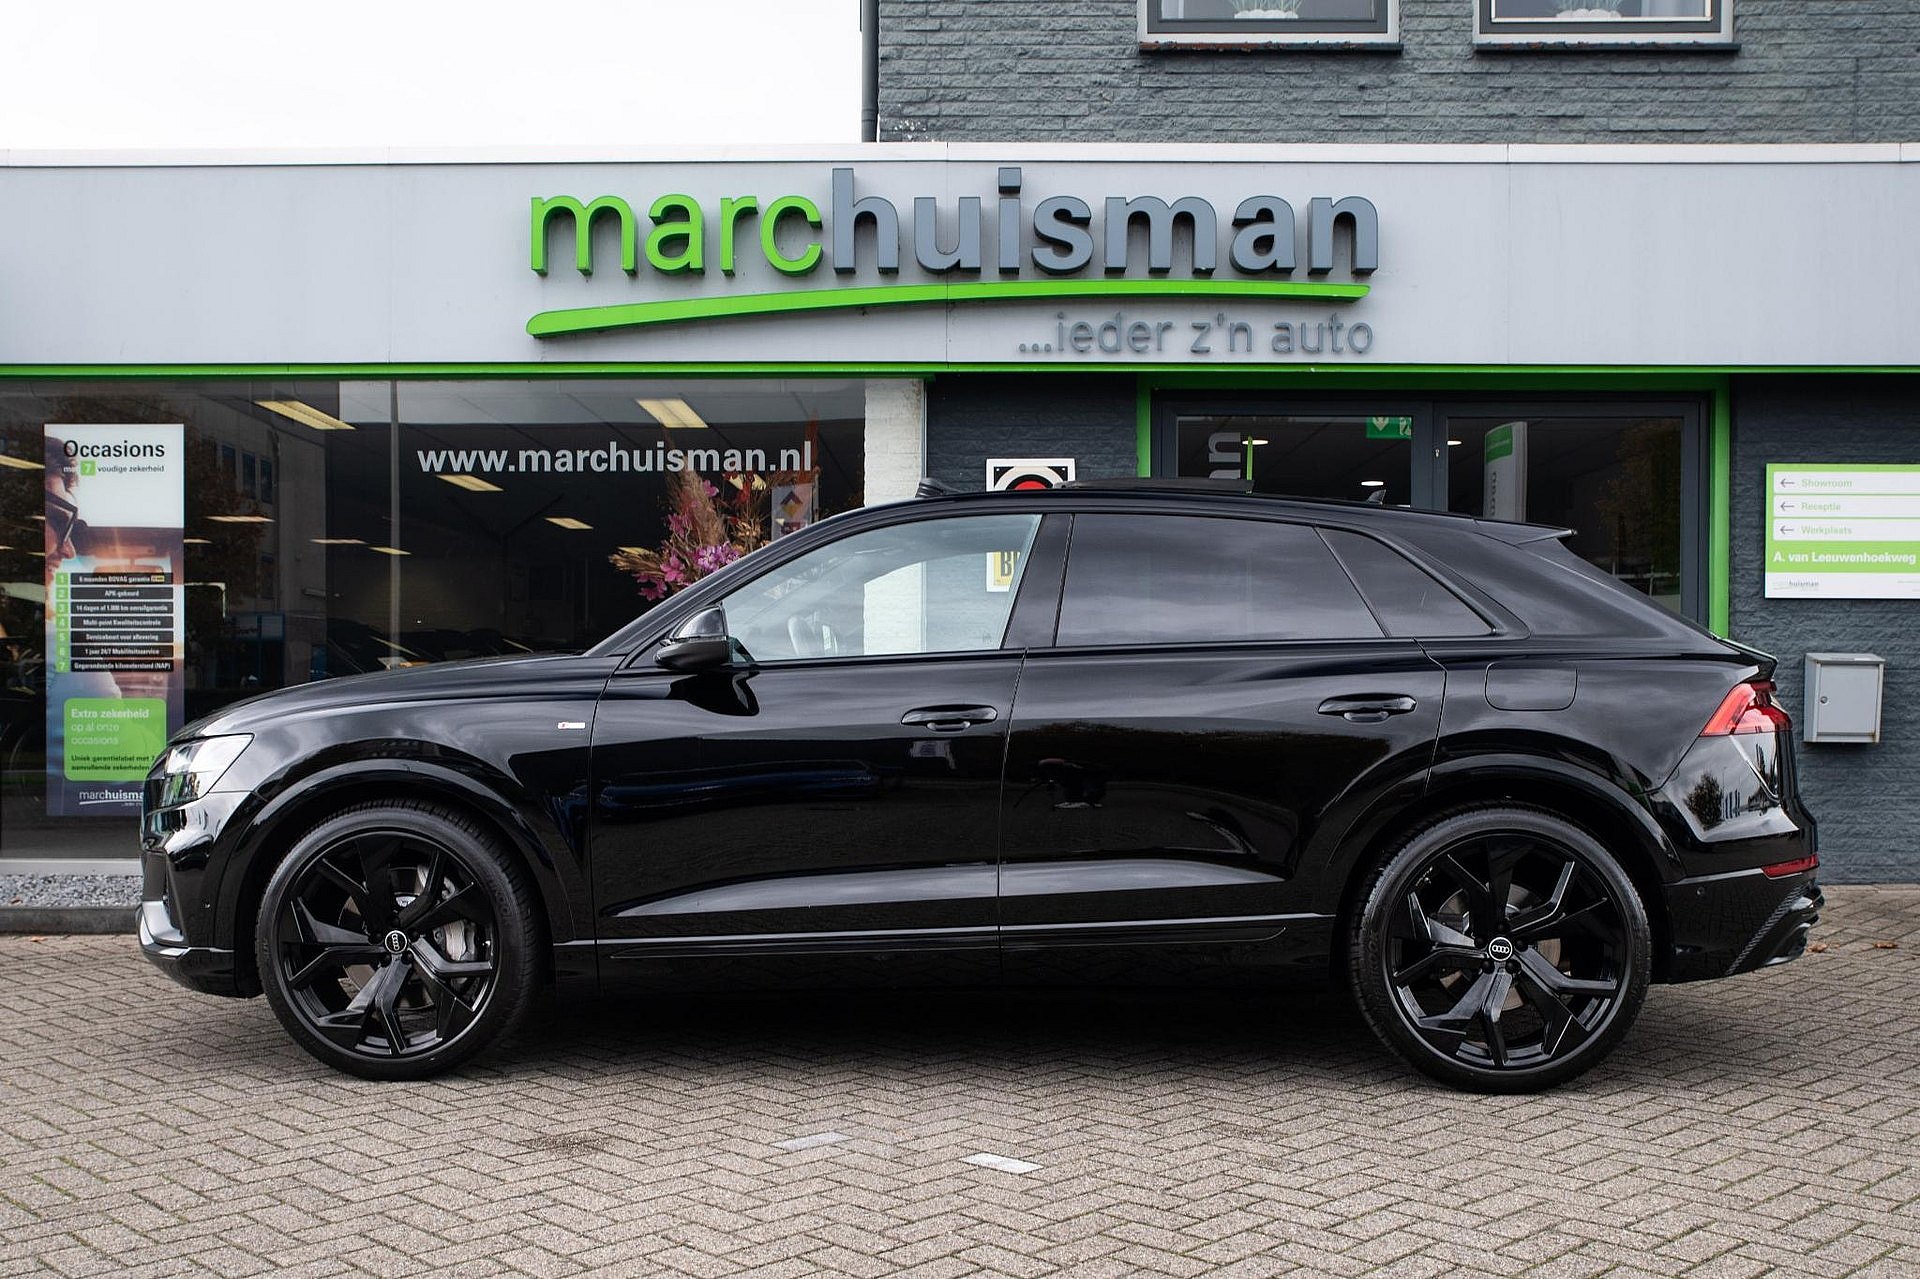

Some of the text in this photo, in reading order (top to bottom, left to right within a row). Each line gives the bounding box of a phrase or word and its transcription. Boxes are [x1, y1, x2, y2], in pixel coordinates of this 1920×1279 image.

[530, 167, 1380, 276] marchuisman
[1190, 311, 1253, 354] z'n
[1271, 311, 1374, 354] auto
[64, 440, 165, 458] Occasions
[417, 440, 812, 473] www.marchuisman.nl
[98, 464, 127, 474] voudige
[129, 464, 165, 473] zekerheid
[1801, 478, 1853, 488] Showroom
[1801, 502, 1841, 512] Receptie
[1801, 525, 1853, 536] Werkplaats
[1773, 551, 1917, 565] A. van Leeuwenhoekweg
[71, 708, 150, 718] Extra zekerheid
[71, 736, 119, 745] occasions
